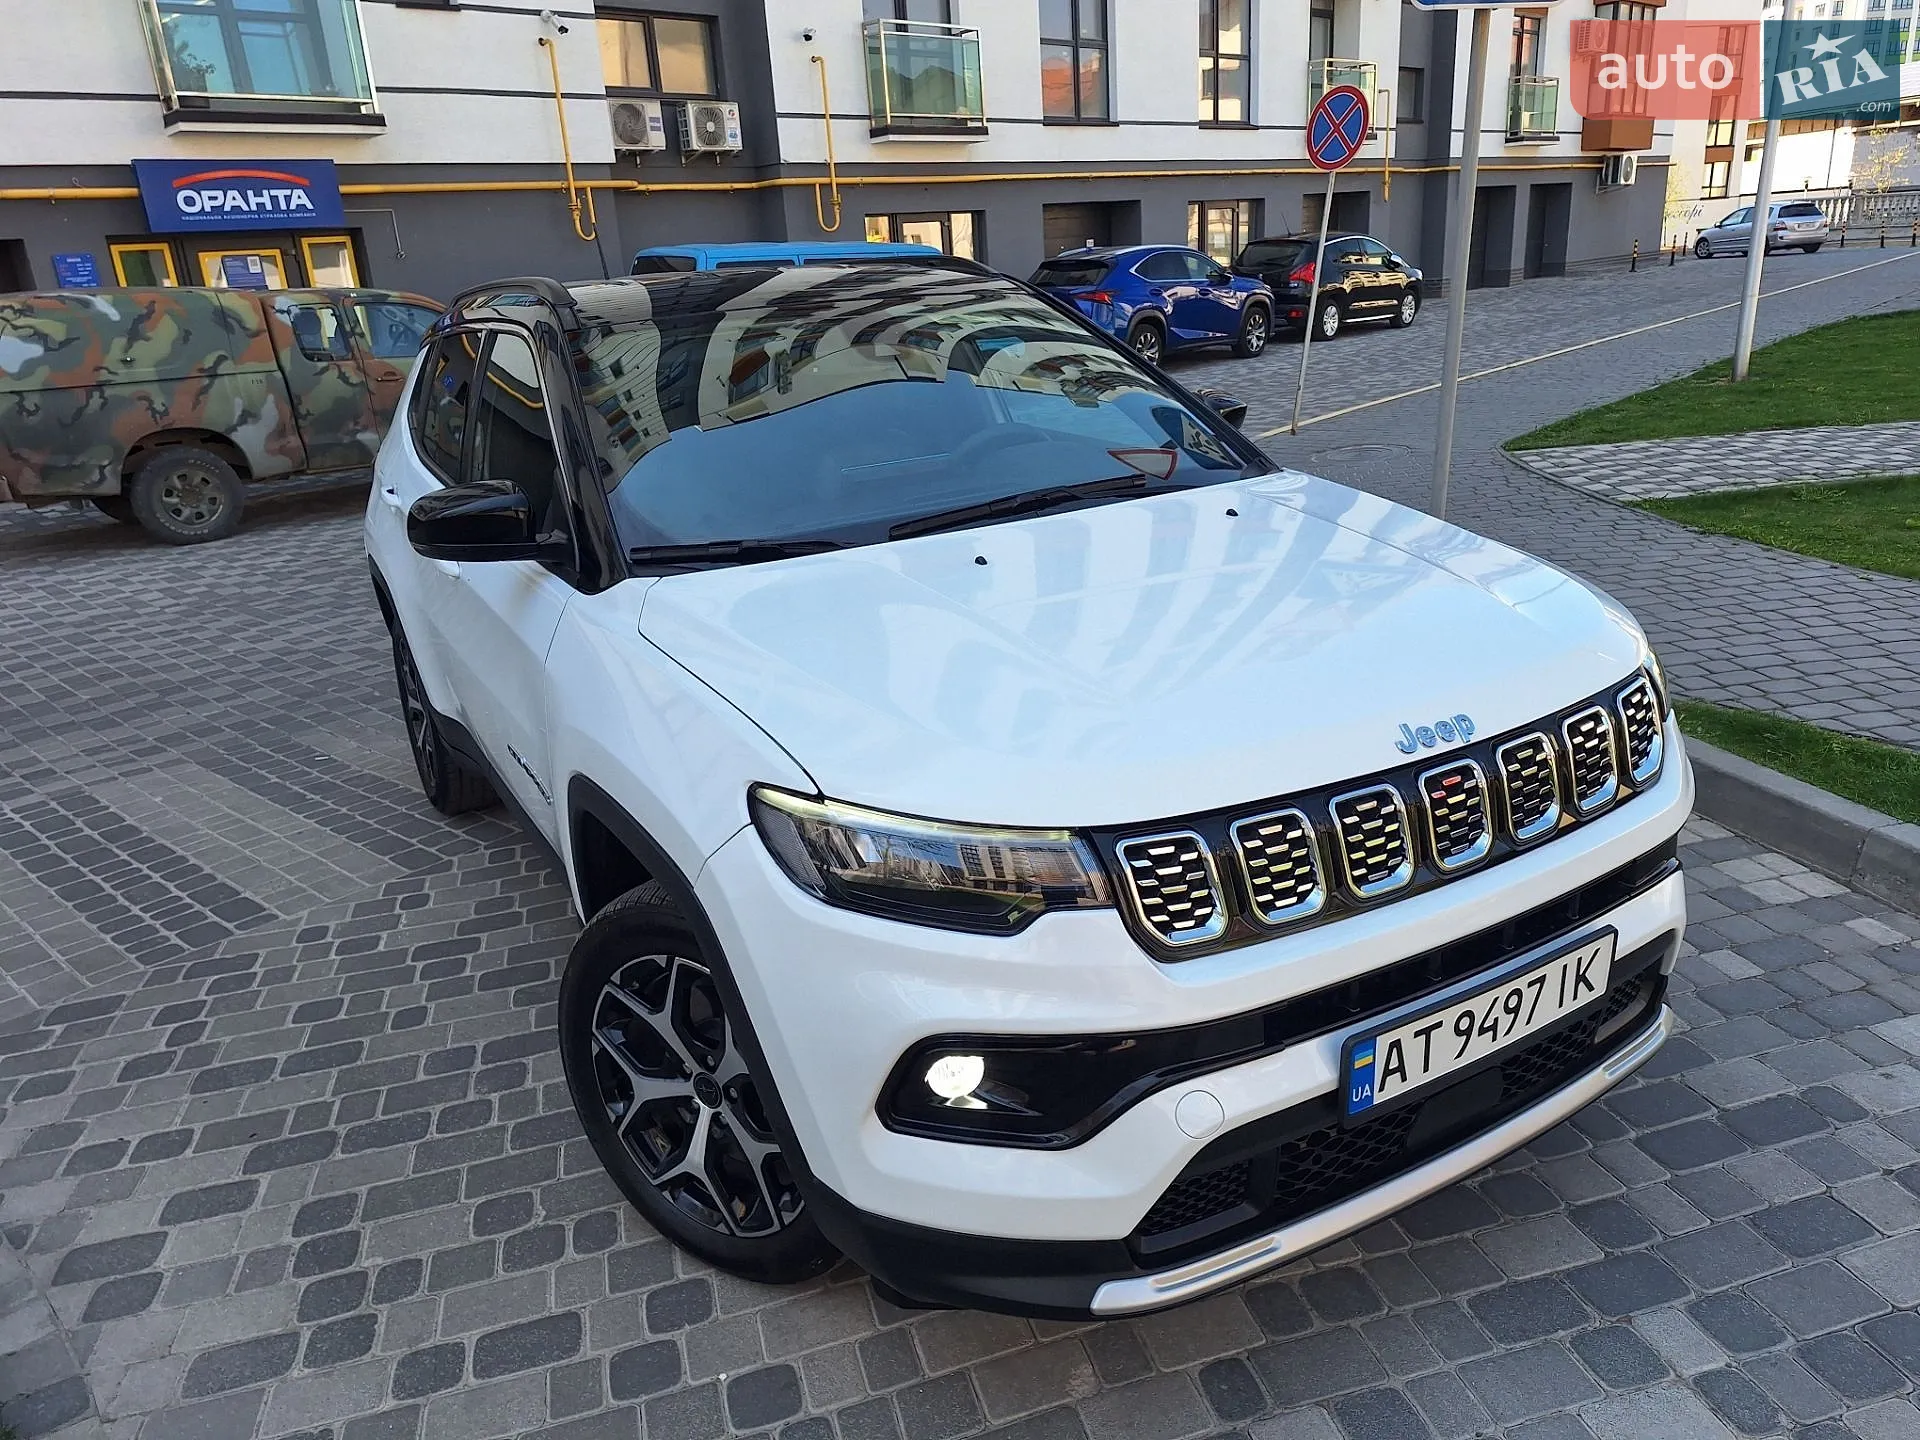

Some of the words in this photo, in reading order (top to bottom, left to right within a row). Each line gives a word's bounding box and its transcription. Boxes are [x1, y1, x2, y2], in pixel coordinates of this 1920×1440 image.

[176, 188, 314, 214] ОРАНТА
[1395, 713, 1476, 755] Jeep
[1378, 1019, 1444, 1094] AT
[1453, 973, 1547, 1061] 9497
[1558, 946, 1602, 1009] IK
[1352, 1083, 1373, 1103] UA
